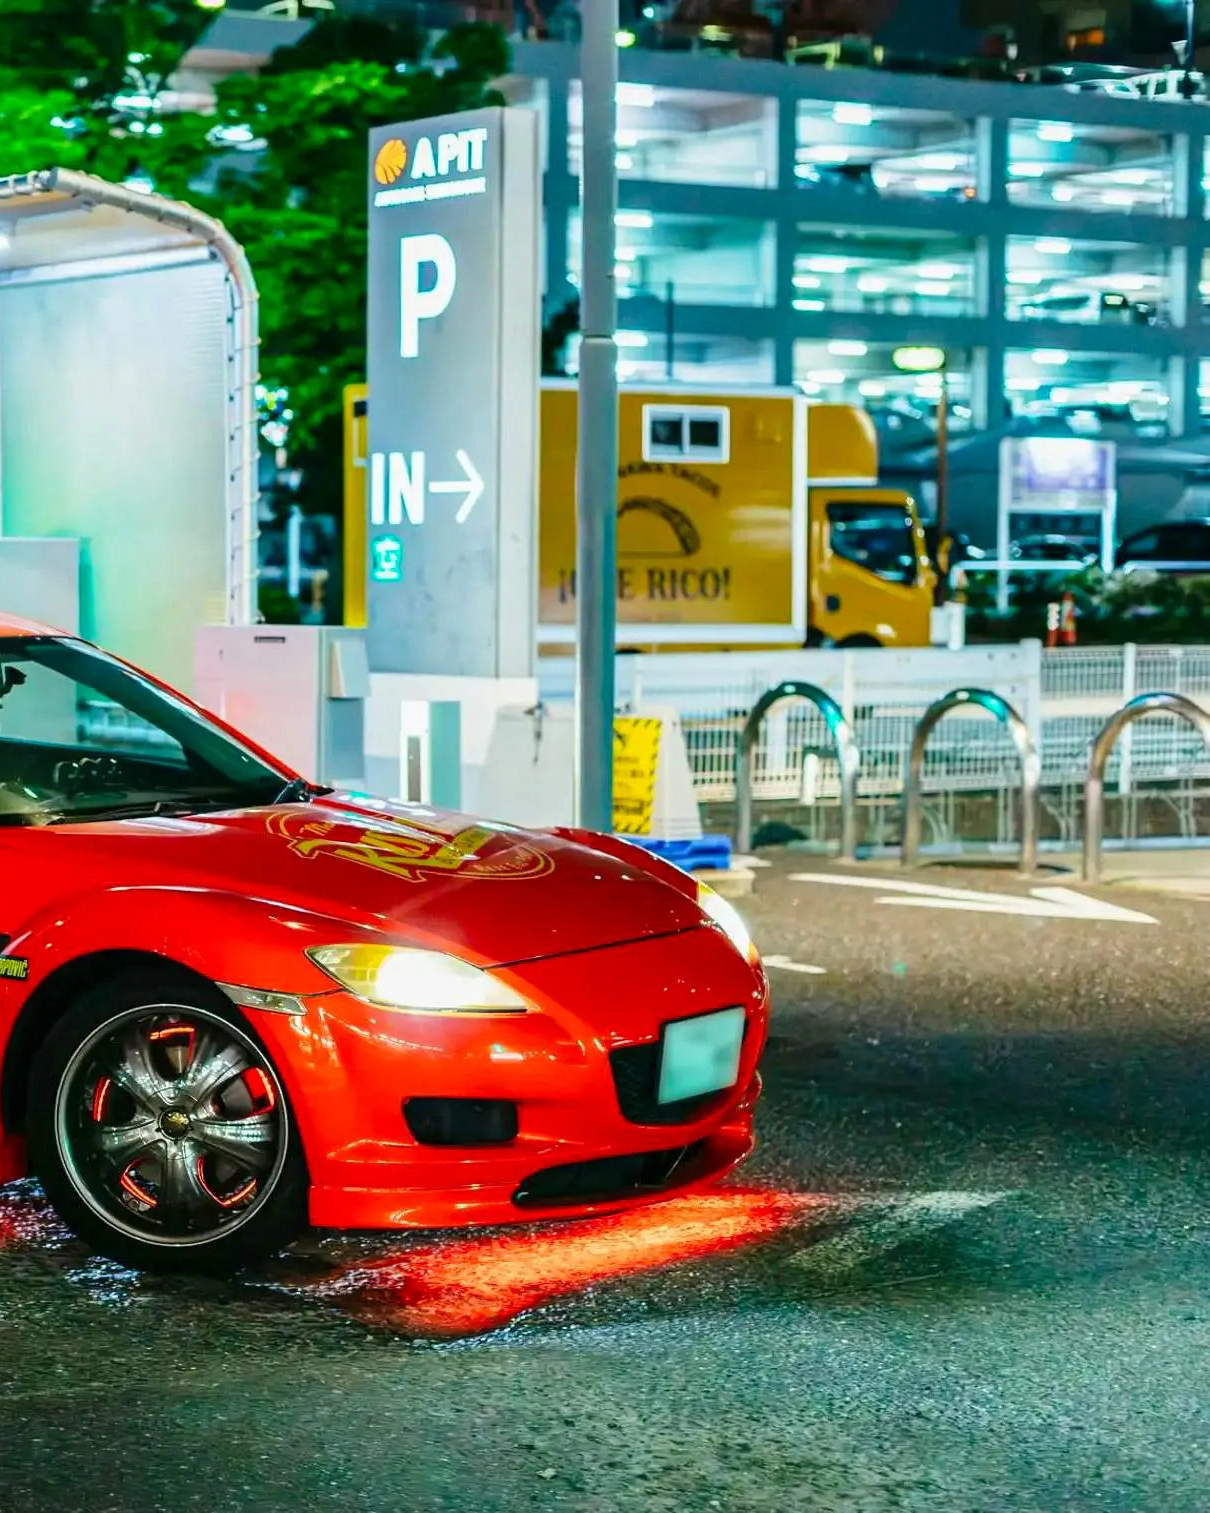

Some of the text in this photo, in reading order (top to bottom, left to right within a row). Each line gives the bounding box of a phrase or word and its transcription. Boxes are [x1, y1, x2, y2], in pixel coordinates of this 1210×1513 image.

[399, 233, 457, 359] P
[371, 450, 425, 525] IN
[646, 566, 732, 601] RICO!
